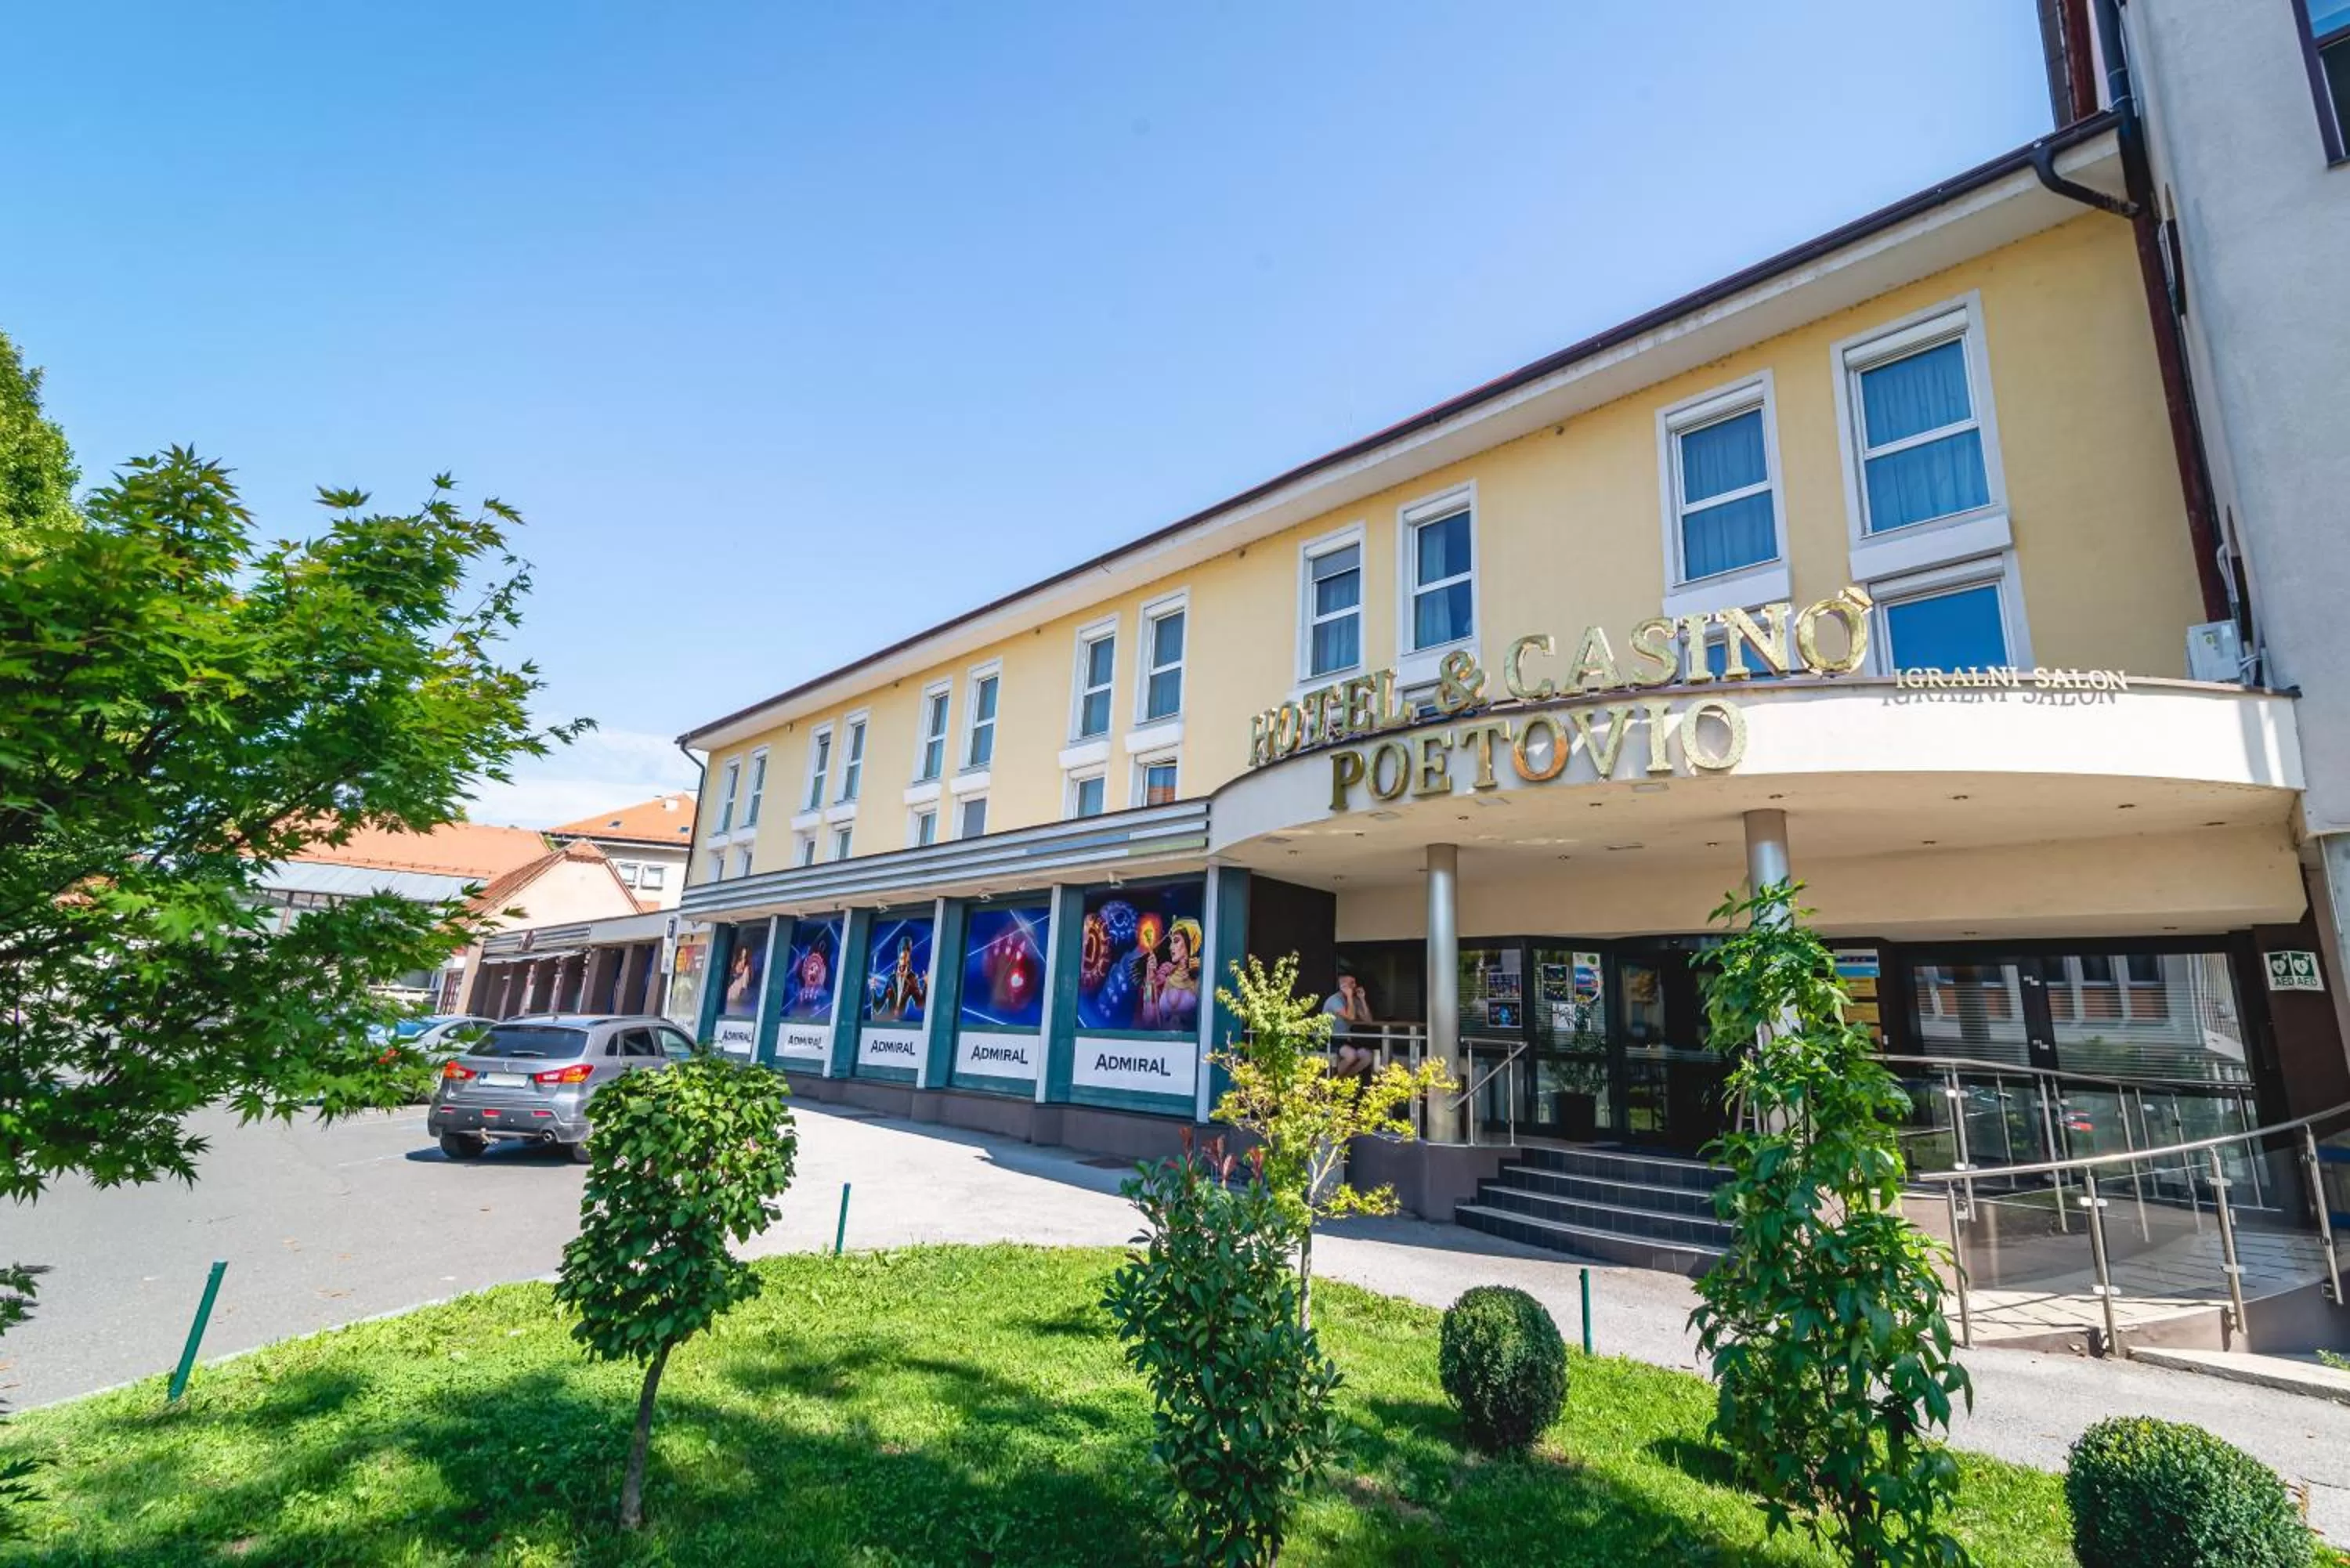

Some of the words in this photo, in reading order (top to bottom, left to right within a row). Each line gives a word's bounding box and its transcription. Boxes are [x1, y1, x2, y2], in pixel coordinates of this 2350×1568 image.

[1896, 666, 2021, 689] IGRALNI
[2033, 667, 2128, 691] SALON
[1249, 667, 1416, 767] HOTEL
[1434, 649, 1491, 715] &
[1329, 699, 1748, 811] POETOVIO
[721, 1029, 752, 1044] ADMIRAL
[787, 1035, 823, 1050] ADMIRAL
[870, 1039, 916, 1056] ADMIRAL
[971, 1045, 1028, 1064] ADMIRAL
[1094, 1053, 1171, 1076] ADMIRAL
